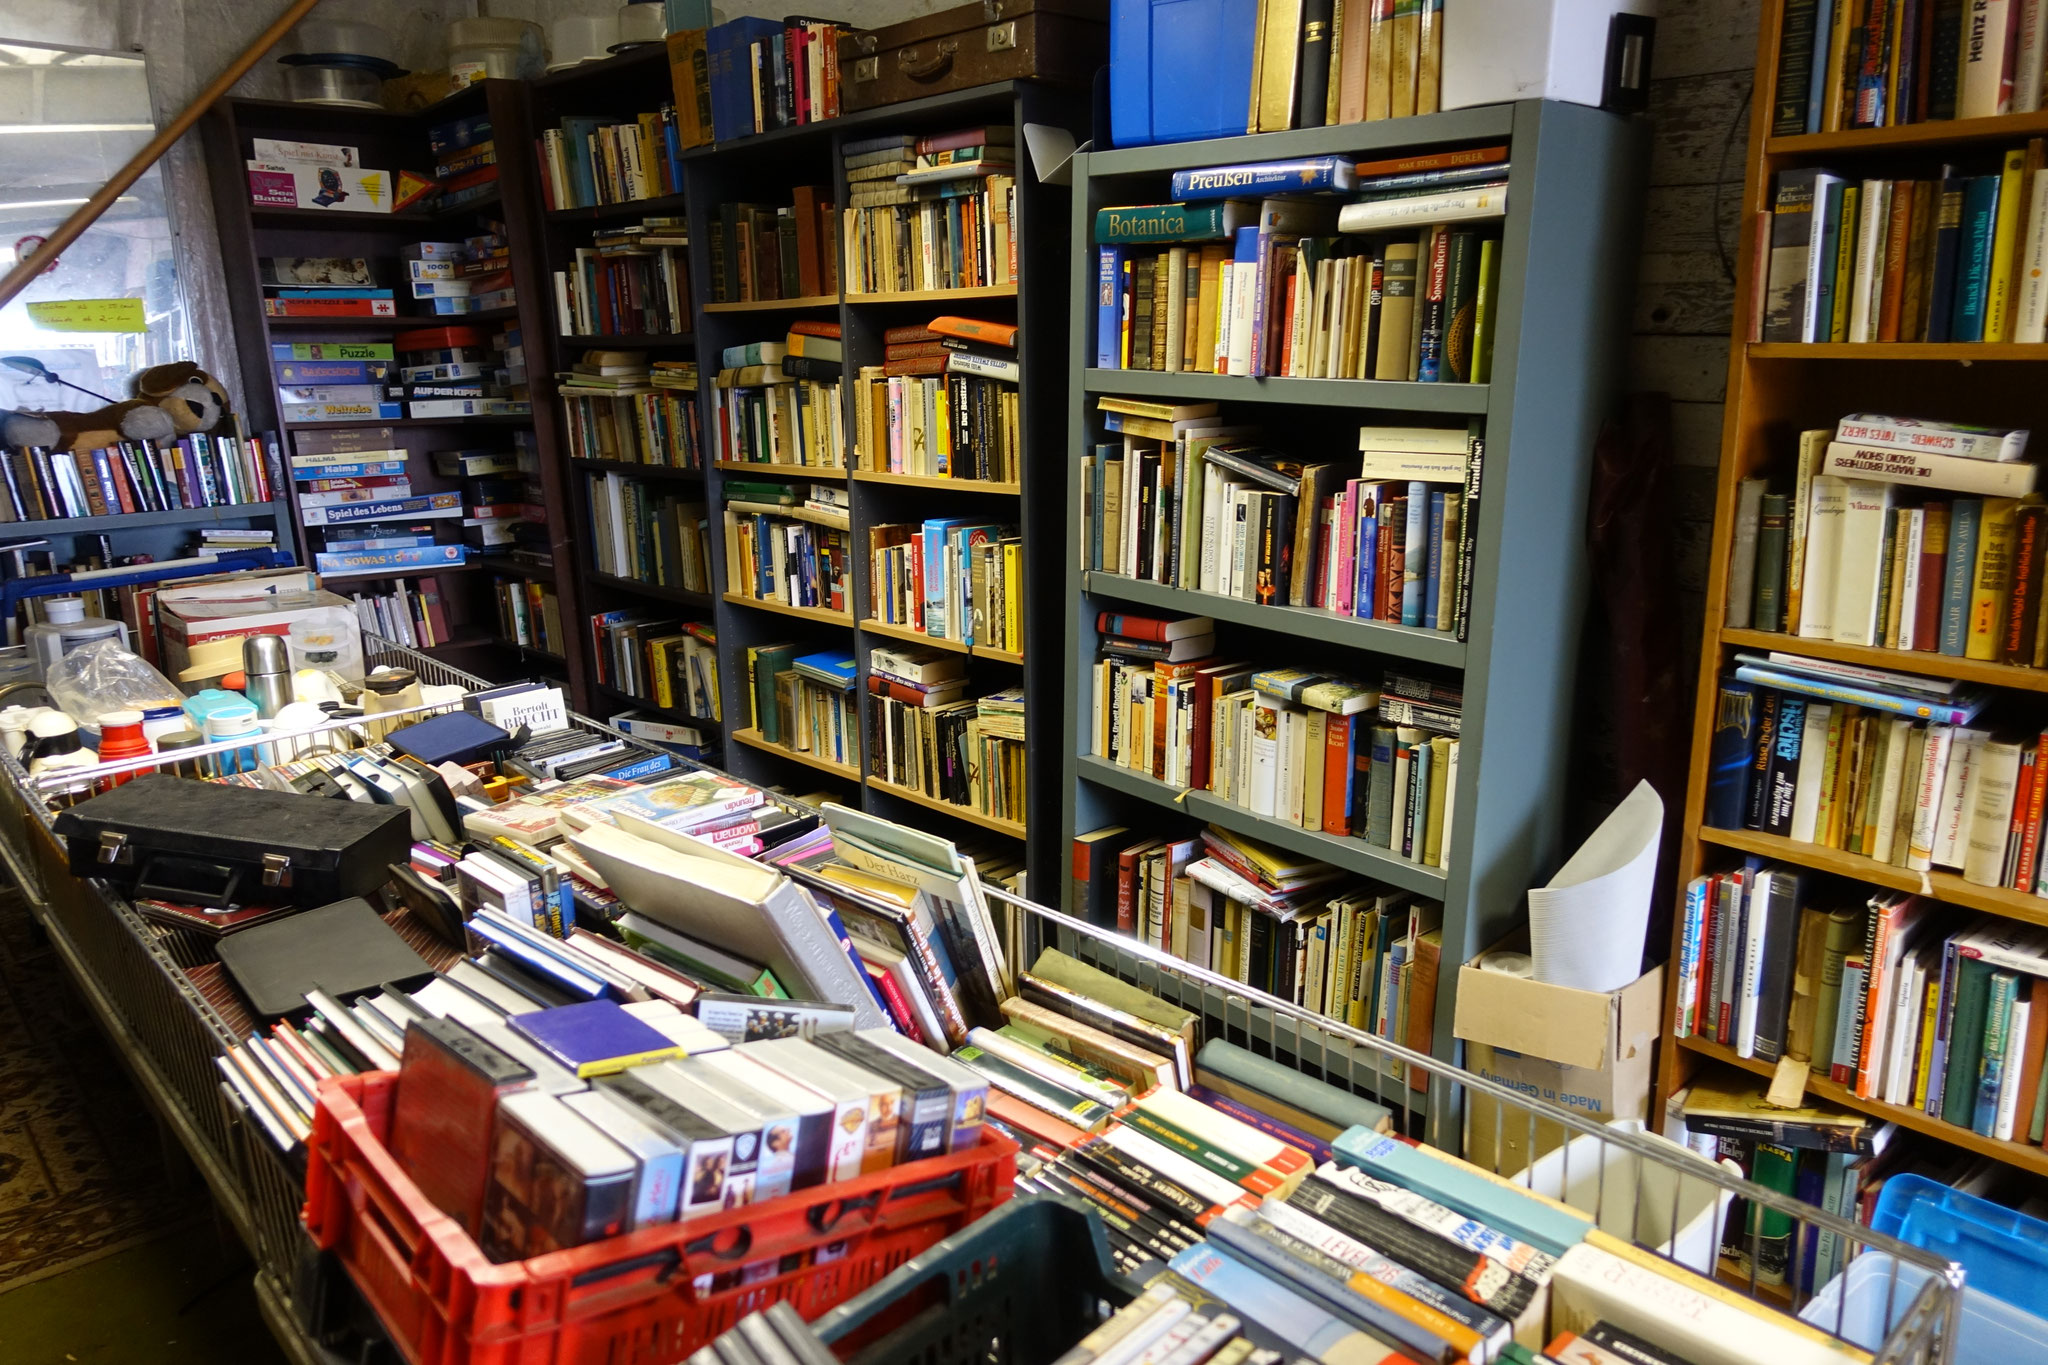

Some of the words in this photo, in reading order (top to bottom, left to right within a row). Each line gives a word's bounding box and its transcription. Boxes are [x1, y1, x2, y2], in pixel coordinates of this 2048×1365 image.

[1968, 14, 1986, 63] Heinz
[1398, 162, 1414, 170] MAX
[1416, 160, 1439, 168] STECK
[1188, 172, 1253, 190] Preußen
[1256, 174, 1287, 184] Architektur
[268, 188, 294, 196] Sea
[1108, 211, 1185, 237] Botanica
[340, 348, 376, 358] Puzzle
[413, 386, 434, 395] AUF
[434, 387, 453, 396] DER
[454, 388, 483, 397] KIPPE
[960, 376, 968, 410] Besitzer
[324, 404, 373, 415] Weltreise
[1842, 425, 1868, 440] HERZ
[1868, 428, 1897, 443] TOTES
[1912, 432, 1957, 448] SCHWEIG
[1834, 458, 1882, 472] BROTHERS
[1854, 450, 1885, 462] SHOW
[1887, 452, 1916, 464] RADIO
[324, 464, 359, 475] Halma
[1467, 440, 1484, 500] Paradiese
[1885, 463, 1916, 476] MARX
[328, 510, 354, 520] Spiel
[353, 507, 370, 517] des
[370, 504, 403, 515] Lebens
[1432, 512, 1441, 526] 642
[1958, 512, 1970, 540] AVILA
[344, 556, 386, 567] SOWAS
[1430, 526, 1440, 578] ALEXANDRIA
[1956, 542, 1966, 563] VON
[1951, 566, 1965, 600] TERESA
[2013, 580, 2026, 595] Der
[1460, 590, 1469, 613] Messner
[2010, 598, 2024, 621] Wohl
[1458, 616, 1467, 640] Grzimek
[1946, 606, 1961, 648] AUCLAIR
[2010, 620, 2020, 630] de
[1900, 633, 1908, 646] dtv
[2007, 630, 2020, 650] Louis
[512, 702, 549, 716] Bertolt
[1760, 696, 1775, 715] Zeit
[504, 708, 560, 730] BRECHT
[1758, 716, 1771, 732] der
[1758, 734, 1768, 744] in
[1776, 700, 1804, 762] Fischer
[1756, 746, 1768, 770] Risse
[618, 769, 632, 780] Die
[631, 765, 650, 777] Frau
[650, 760, 661, 770] des
[1776, 771, 1786, 784] mit
[1784, 782, 1796, 800] Eine
[724, 794, 756, 811] freundin
[1781, 802, 1792, 818] Frau
[714, 822, 758, 842] woman
[864, 854, 884, 871] Der
[886, 862, 921, 885] Harz
[911, 917, 930, 949] Urzeit
[1679, 904, 1696, 978] Fußball-Jahrbuch
[1860, 906, 1879, 982] TIERGESICHTER
[925, 948, 936, 966] der
[1338, 953, 1346, 974] TIERE
[1870, 918, 1887, 990] Schimpansenkinder
[933, 967, 942, 980] in
[936, 979, 968, 1035] Deutschland
[1856, 990, 1868, 1020] DATHE
[1850, 1024, 1864, 1068] HEINRICH
[1989, 1037, 1999, 1052] DAS
[1480, 1067, 1540, 1098] Germany
[1543, 1088, 1556, 1104] in
[1560, 1093, 1601, 1112] Made
[1719, 1141, 1744, 1160] Haley
[1756, 1143, 1793, 1163] ALASKA
[1320, 1236, 1370, 1270] LEVEL
[1370, 1262, 1401, 1284] 26
